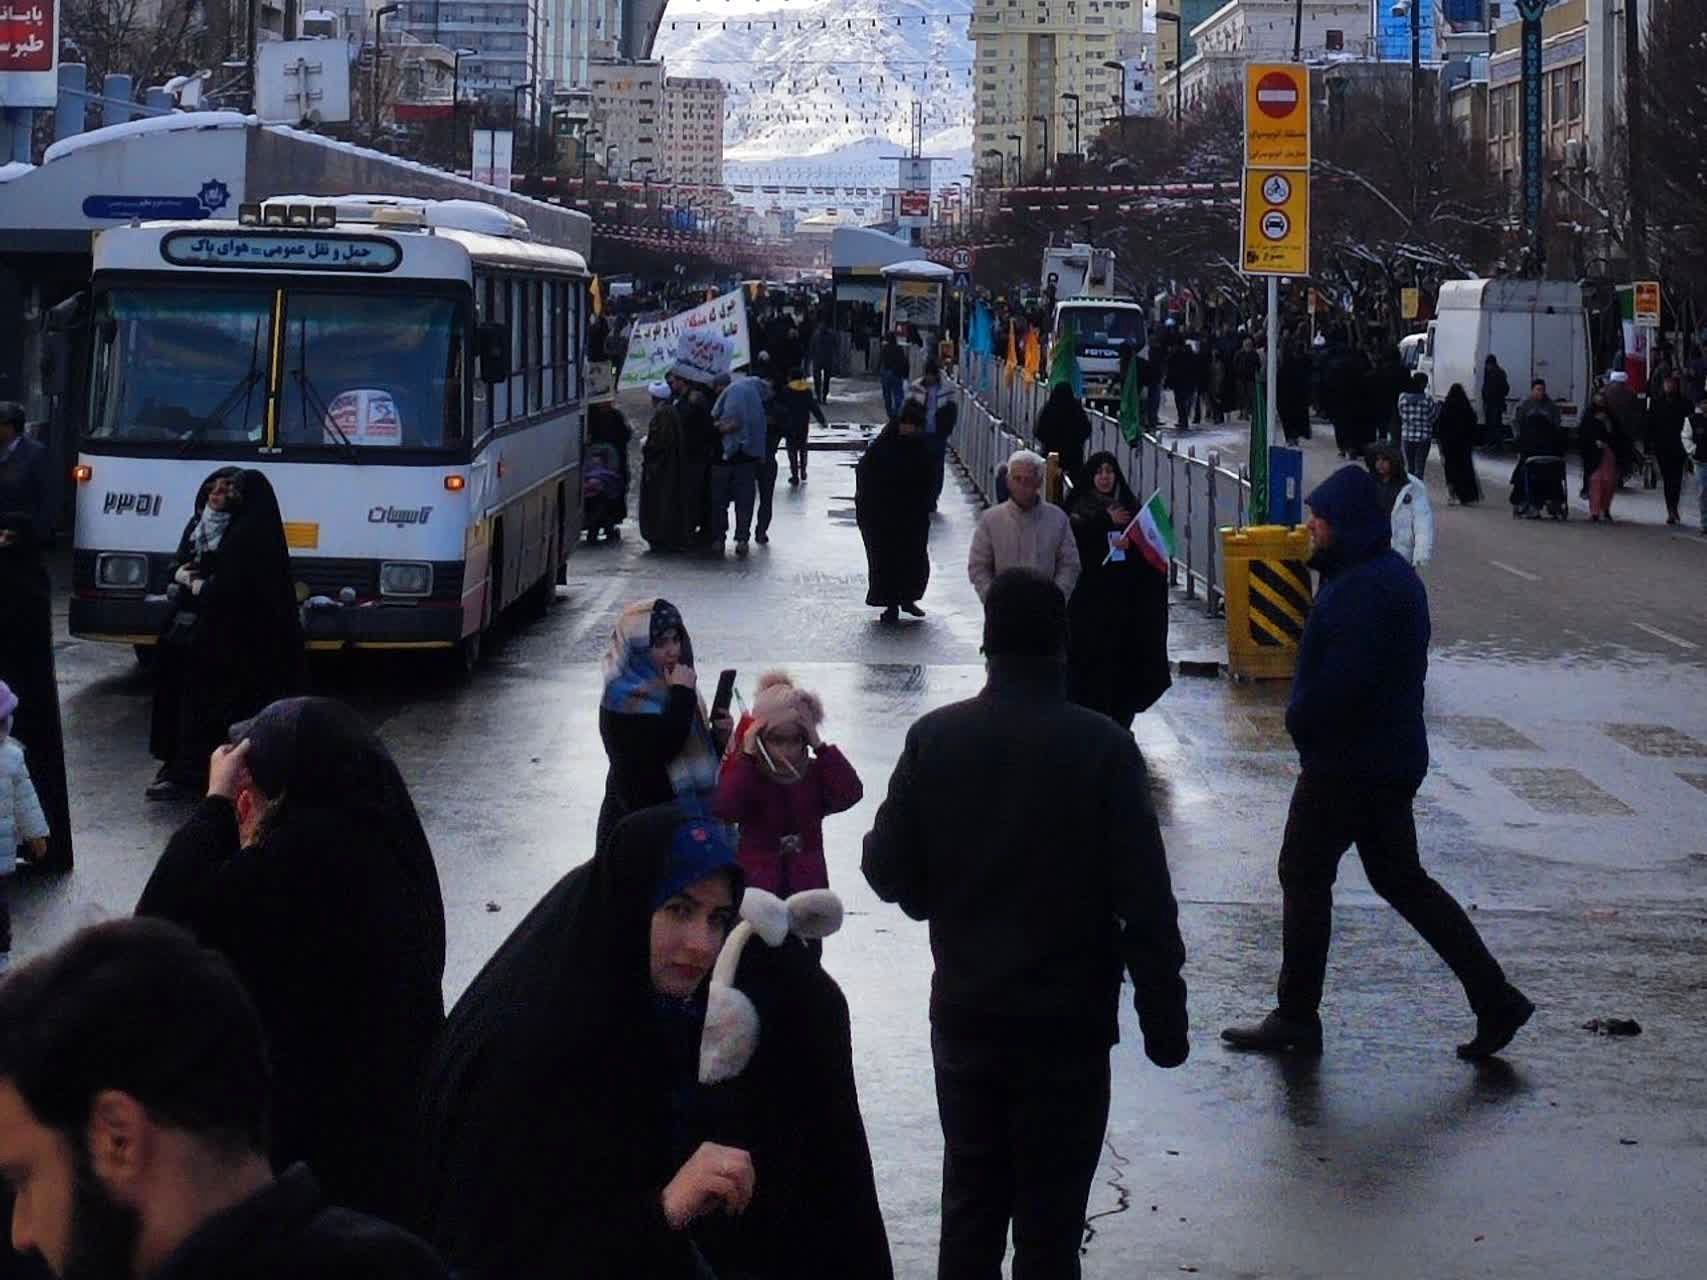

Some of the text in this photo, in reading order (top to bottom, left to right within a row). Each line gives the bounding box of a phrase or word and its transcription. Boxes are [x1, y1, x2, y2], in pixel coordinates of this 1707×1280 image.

[0, 5, 43, 26] پایان
[190, 239, 214, 255] پاک
[216, 240, 250, 257] هوای
[263, 243, 305, 259] عمومی
[307, 243, 330, 260] نقل
[331, 249, 340, 261] و
[342, 244, 371, 261] حمل
